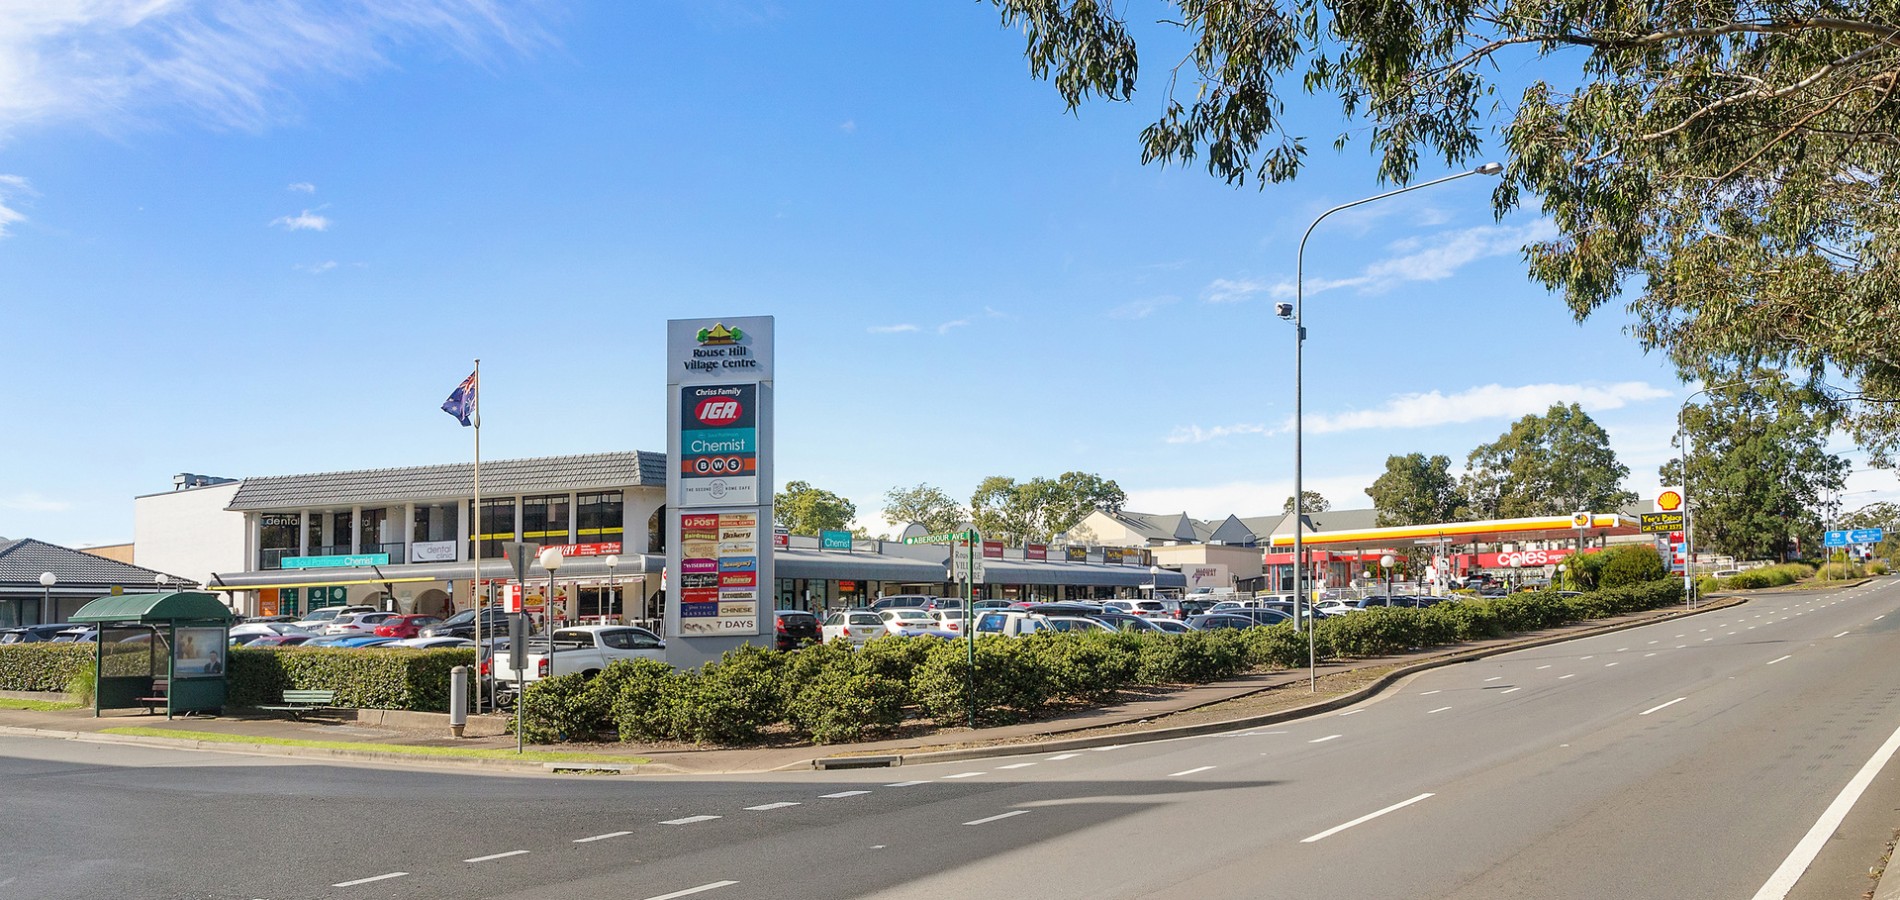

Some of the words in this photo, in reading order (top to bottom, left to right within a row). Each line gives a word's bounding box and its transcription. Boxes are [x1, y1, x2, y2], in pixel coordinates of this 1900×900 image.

[693, 348, 725, 357] Rouse
[729, 346, 746, 356] Hill
[684, 360, 718, 372] Village
[722, 359, 756, 368] Centre
[696, 388, 717, 396] Chriss
[718, 387, 742, 397] Family
[700, 402, 738, 420] IGA
[691, 438, 745, 452] Chemist
[266, 517, 300, 526] dental
[1642, 515, 1661, 523] Yee's
[1661, 514, 1683, 522] Palace
[722, 531, 752, 540] Bakery
[913, 535, 949, 544] ABERDOUR
[824, 538, 850, 548] Chemist
[426, 545, 452, 553] dental
[344, 557, 373, 566] Chemist
[1497, 551, 1548, 566] coles
[955, 562, 982, 570] VILLGE
[725, 620, 754, 628] DAYS
